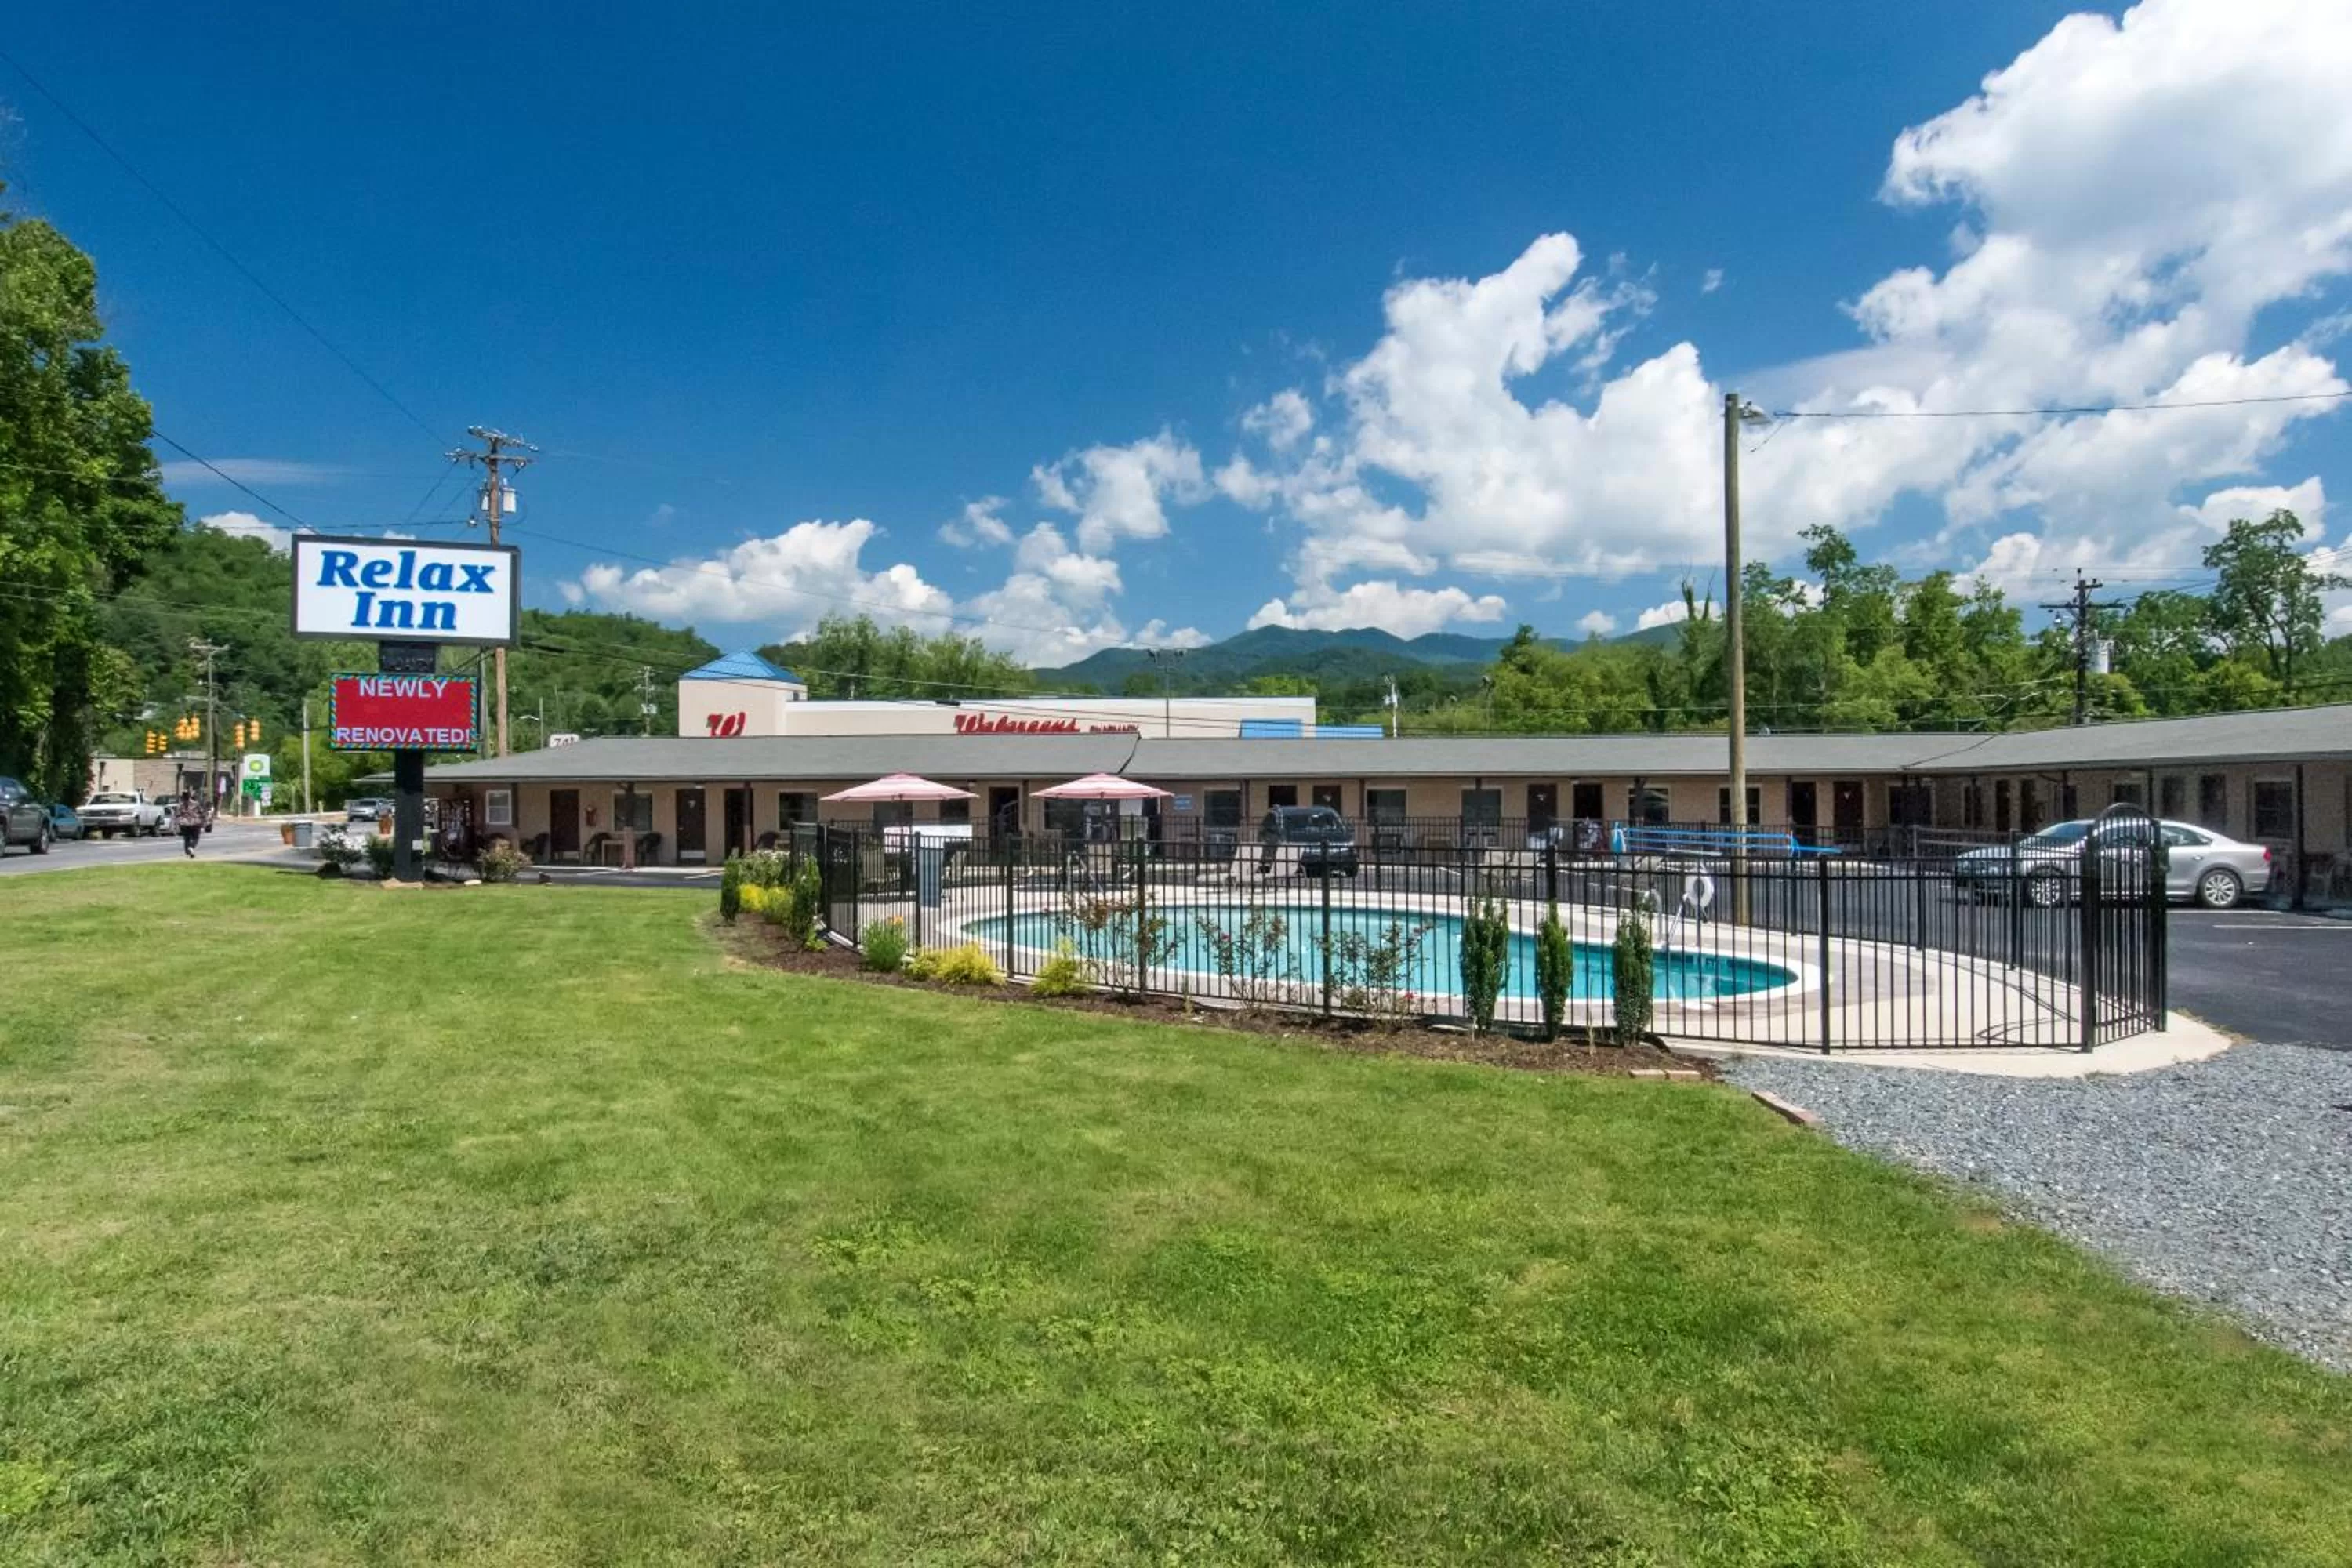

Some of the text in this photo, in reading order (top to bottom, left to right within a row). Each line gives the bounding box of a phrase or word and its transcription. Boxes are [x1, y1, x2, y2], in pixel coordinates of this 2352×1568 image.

[317, 550, 495, 593] Relax
[351, 591, 456, 630] Inn
[359, 678, 448, 698] NEWLY
[336, 727, 470, 743] RENOVATED!
